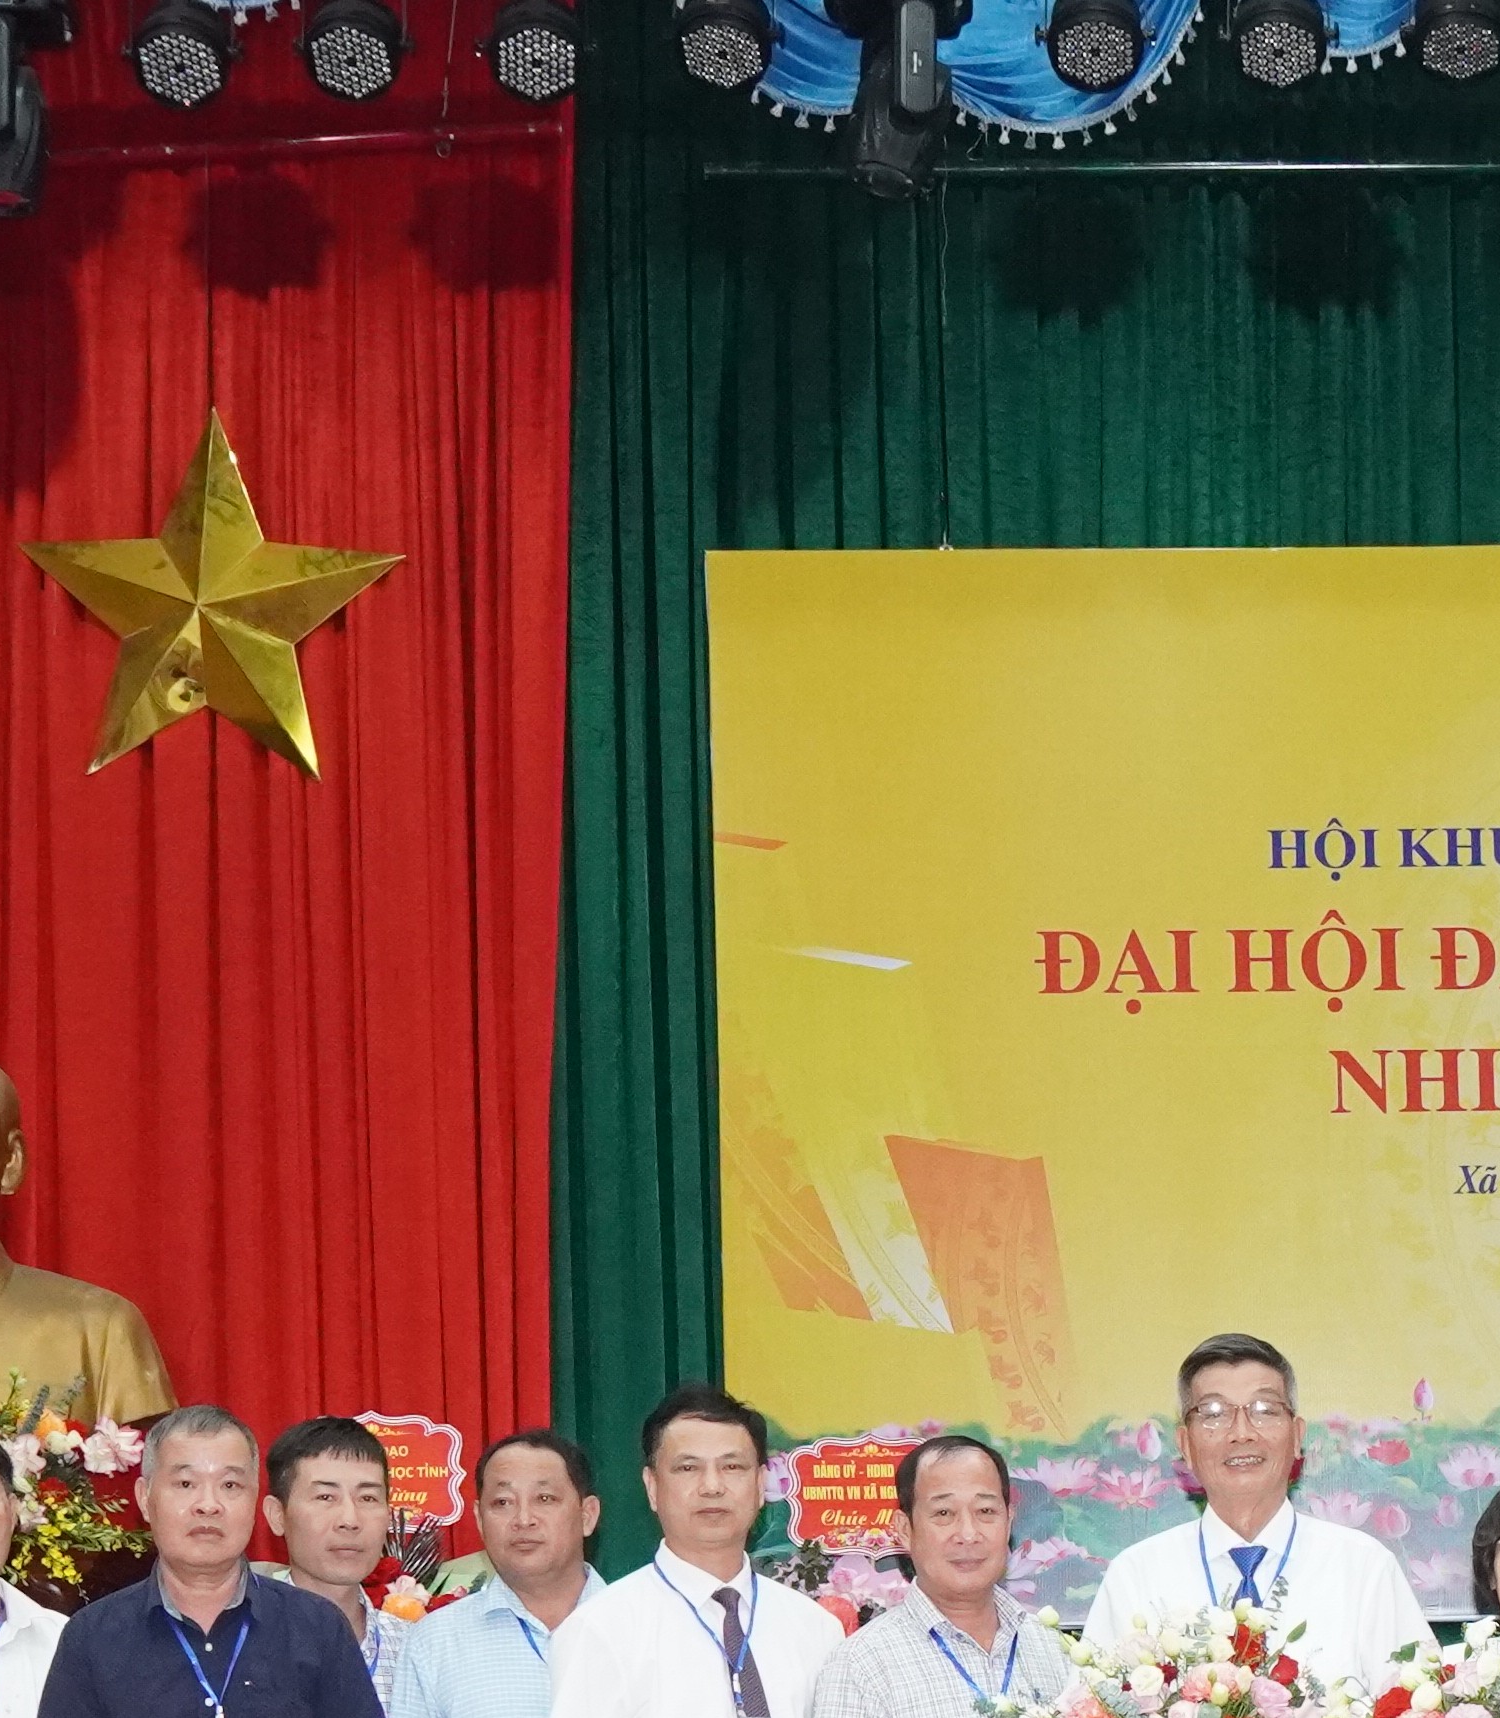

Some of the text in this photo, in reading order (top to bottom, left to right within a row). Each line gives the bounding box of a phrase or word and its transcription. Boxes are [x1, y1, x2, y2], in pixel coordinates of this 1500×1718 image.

[1268, 817, 1381, 882] HỘI
[1034, 928, 1200, 1015] ĐẠI
[1226, 909, 1406, 1013] HỘI
[1454, 1164, 1498, 1195] Xã
[416, 1462, 449, 1478] TỈNH
[389, 1486, 428, 1505] ừng
[802, 1485, 845, 1501] UBMTTQ
[863, 1482, 878, 1500] XÃ
